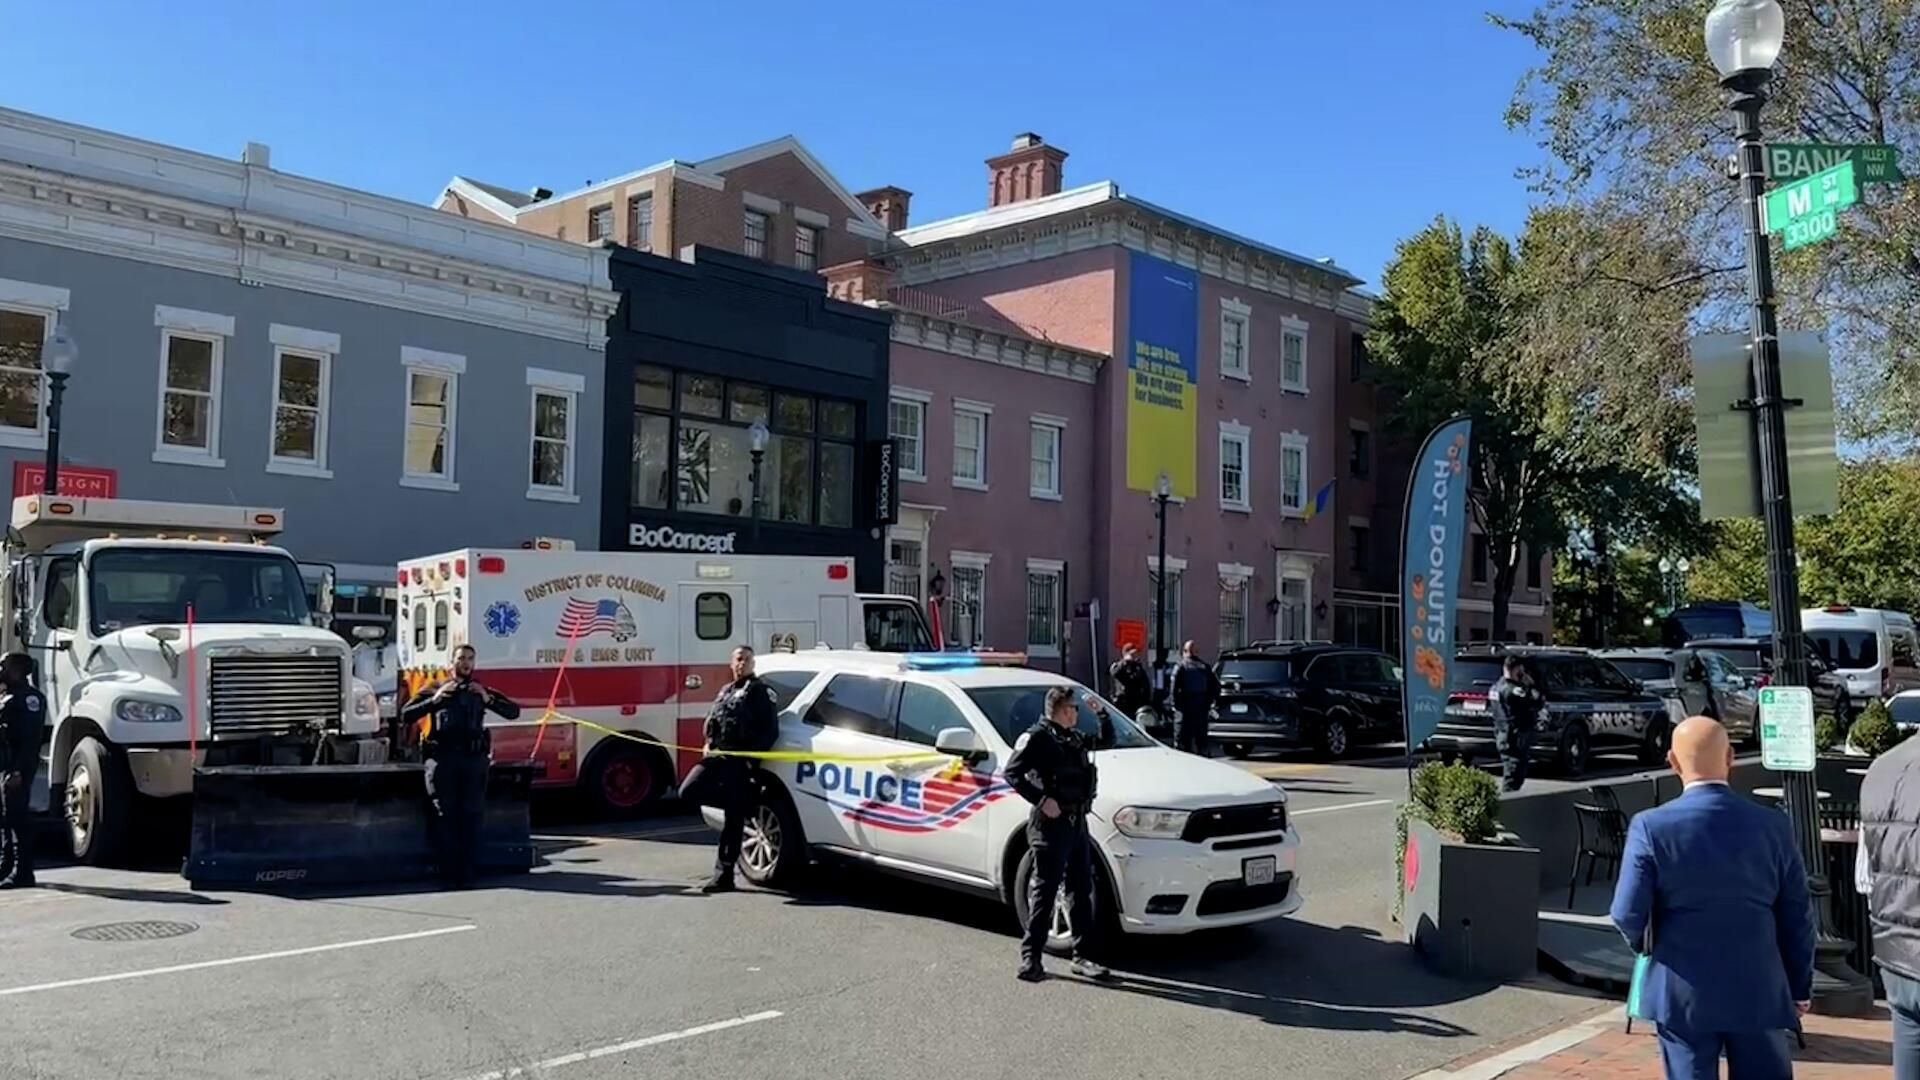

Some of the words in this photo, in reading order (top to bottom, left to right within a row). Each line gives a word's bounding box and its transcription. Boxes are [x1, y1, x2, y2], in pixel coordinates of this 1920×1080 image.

[1861, 148, 1889, 161] ALLEY
[1866, 164, 1886, 177] NW
[1821, 173, 1838, 190] ST
[1787, 183, 1812, 218] M
[1786, 212, 1833, 245] 3300
[1136, 340, 1149, 356] We
[1151, 346, 1163, 359] are
[1136, 356, 1149, 371] We
[1151, 361, 1163, 375] are
[1136, 371, 1148, 386] We
[1150, 376, 1162, 390] are
[1164, 379, 1183, 394] open
[1135, 387, 1147, 401] for
[33, 475, 101, 489] DSIGN
[880, 444, 891, 519] BoConcept
[1432, 460, 1450, 517] HOT
[629, 523, 736, 554] BoConcept
[524, 574, 583, 602] DISTRICT
[585, 573, 603, 588] OF
[606, 575, 667, 603] COLUMBIA
[1427, 531, 1446, 644] DONUTS
[573, 649, 584, 662] &
[591, 648, 619, 662] EMS
[625, 648, 655, 662] UNIT
[1764, 691, 1773, 703] 2
[1591, 711, 1634, 730] POLICE
[795, 760, 922, 809] POLICE
